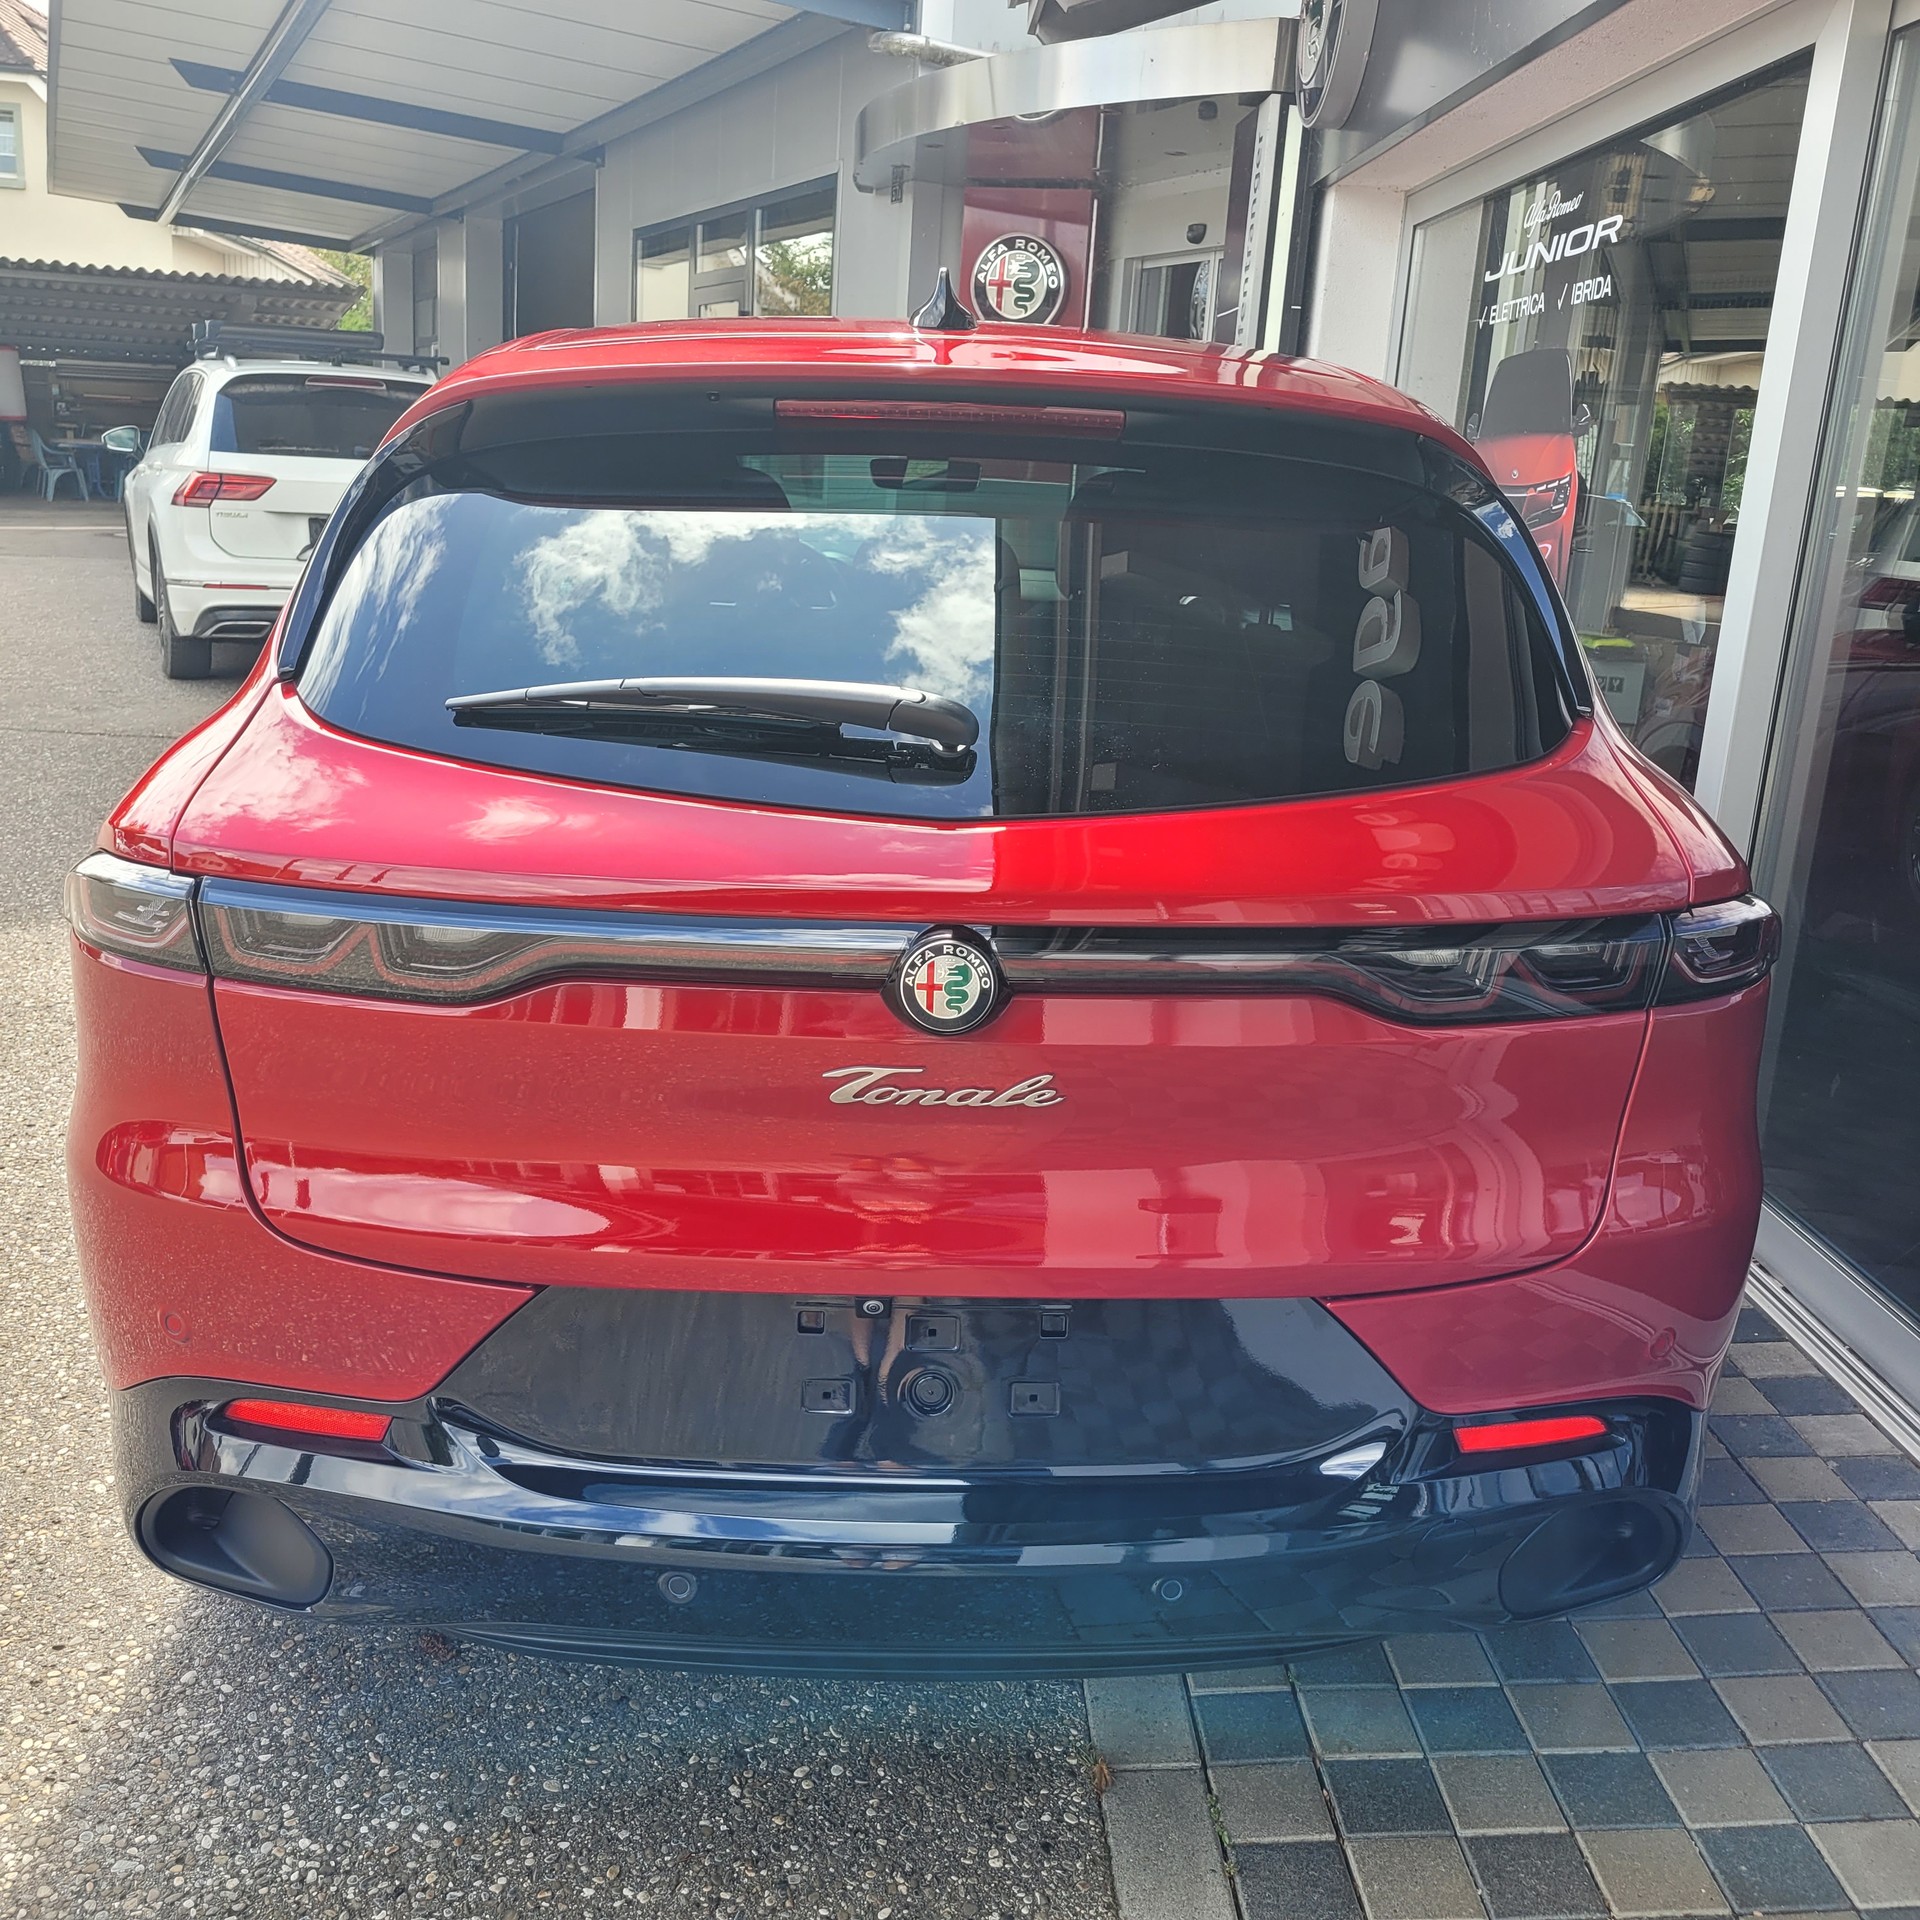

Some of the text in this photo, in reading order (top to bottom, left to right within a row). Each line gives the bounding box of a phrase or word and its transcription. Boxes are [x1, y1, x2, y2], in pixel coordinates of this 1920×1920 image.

[1524, 190, 1584, 238] Alfa Romeo
[977, 239, 1059, 289] ALFA ROMEO
[1484, 214, 1624, 282] JUNIOR
[1489, 292, 1545, 325] ELETTRICA
[1570, 275, 1612, 305] IBRIDA
[905, 944, 991, 989] ALFA ROMEO
[822, 1065, 1066, 1108] Tonale
